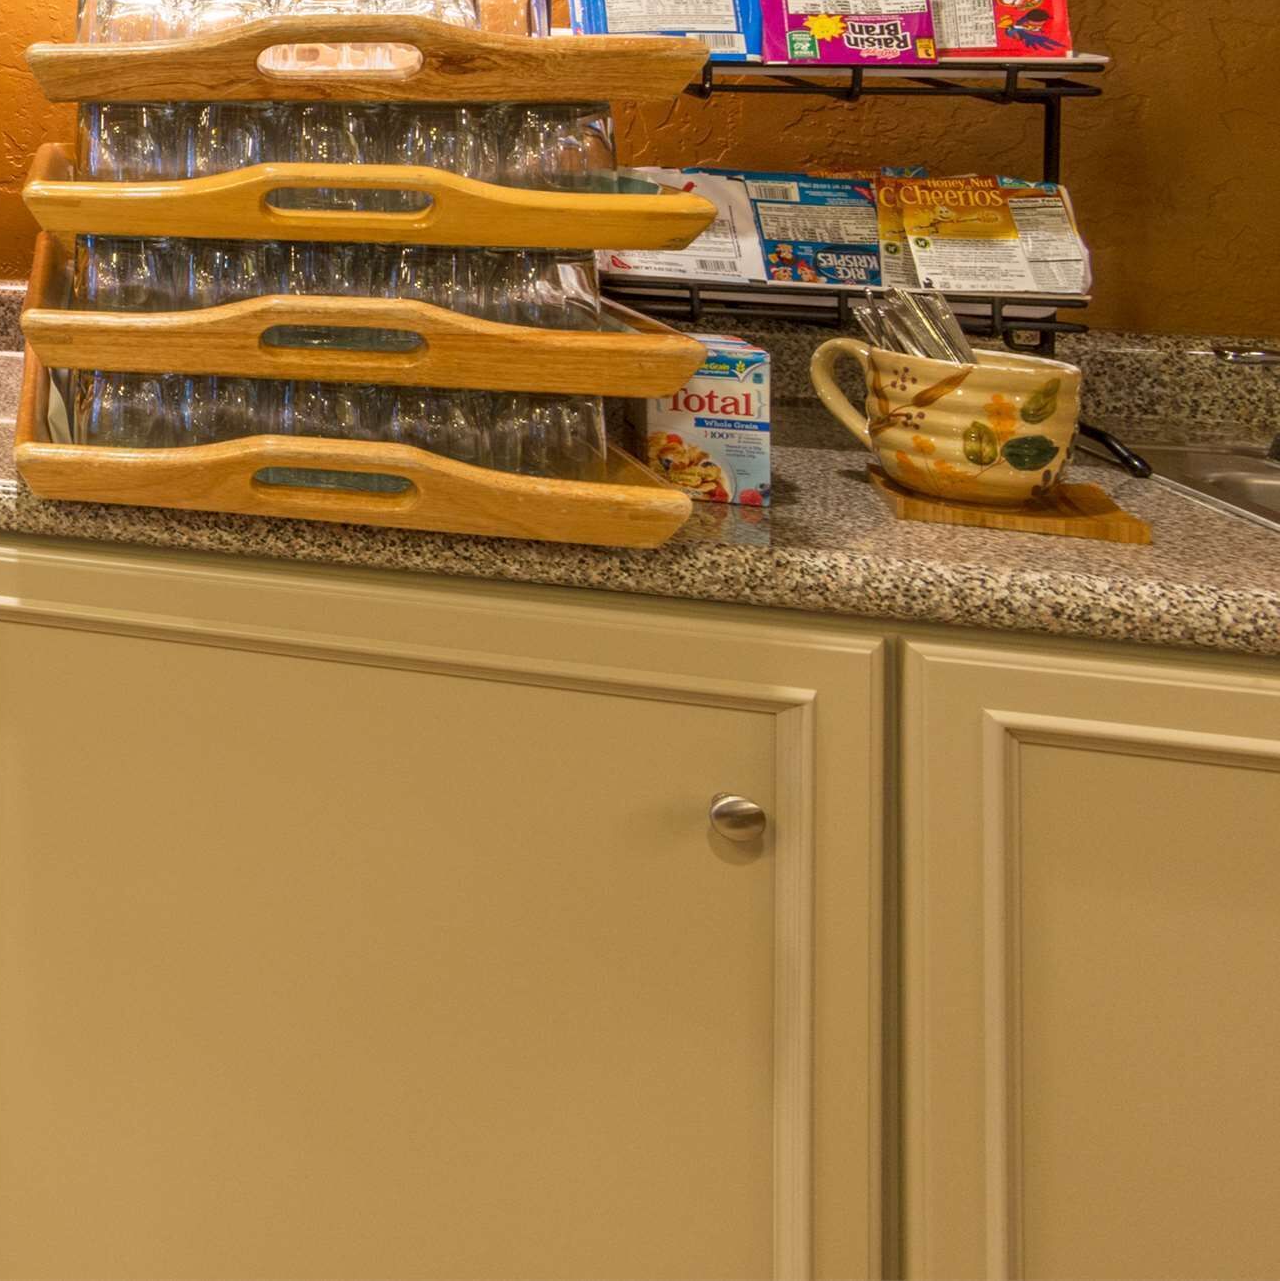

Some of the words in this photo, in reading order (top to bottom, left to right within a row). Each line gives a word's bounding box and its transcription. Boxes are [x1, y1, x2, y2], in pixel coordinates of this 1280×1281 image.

[848, 21, 901, 36] Bran
[845, 34, 911, 50] Raisin
[927, 179, 965, 190] Honey
[971, 177, 994, 188] Nut
[899, 185, 1004, 207] Cheerios
[817, 253, 880, 271] KRISPIES
[836, 267, 867, 280] RICE
[669, 387, 754, 417] Total
[704, 420, 732, 428] Whole
[733, 422, 758, 430] Grain
